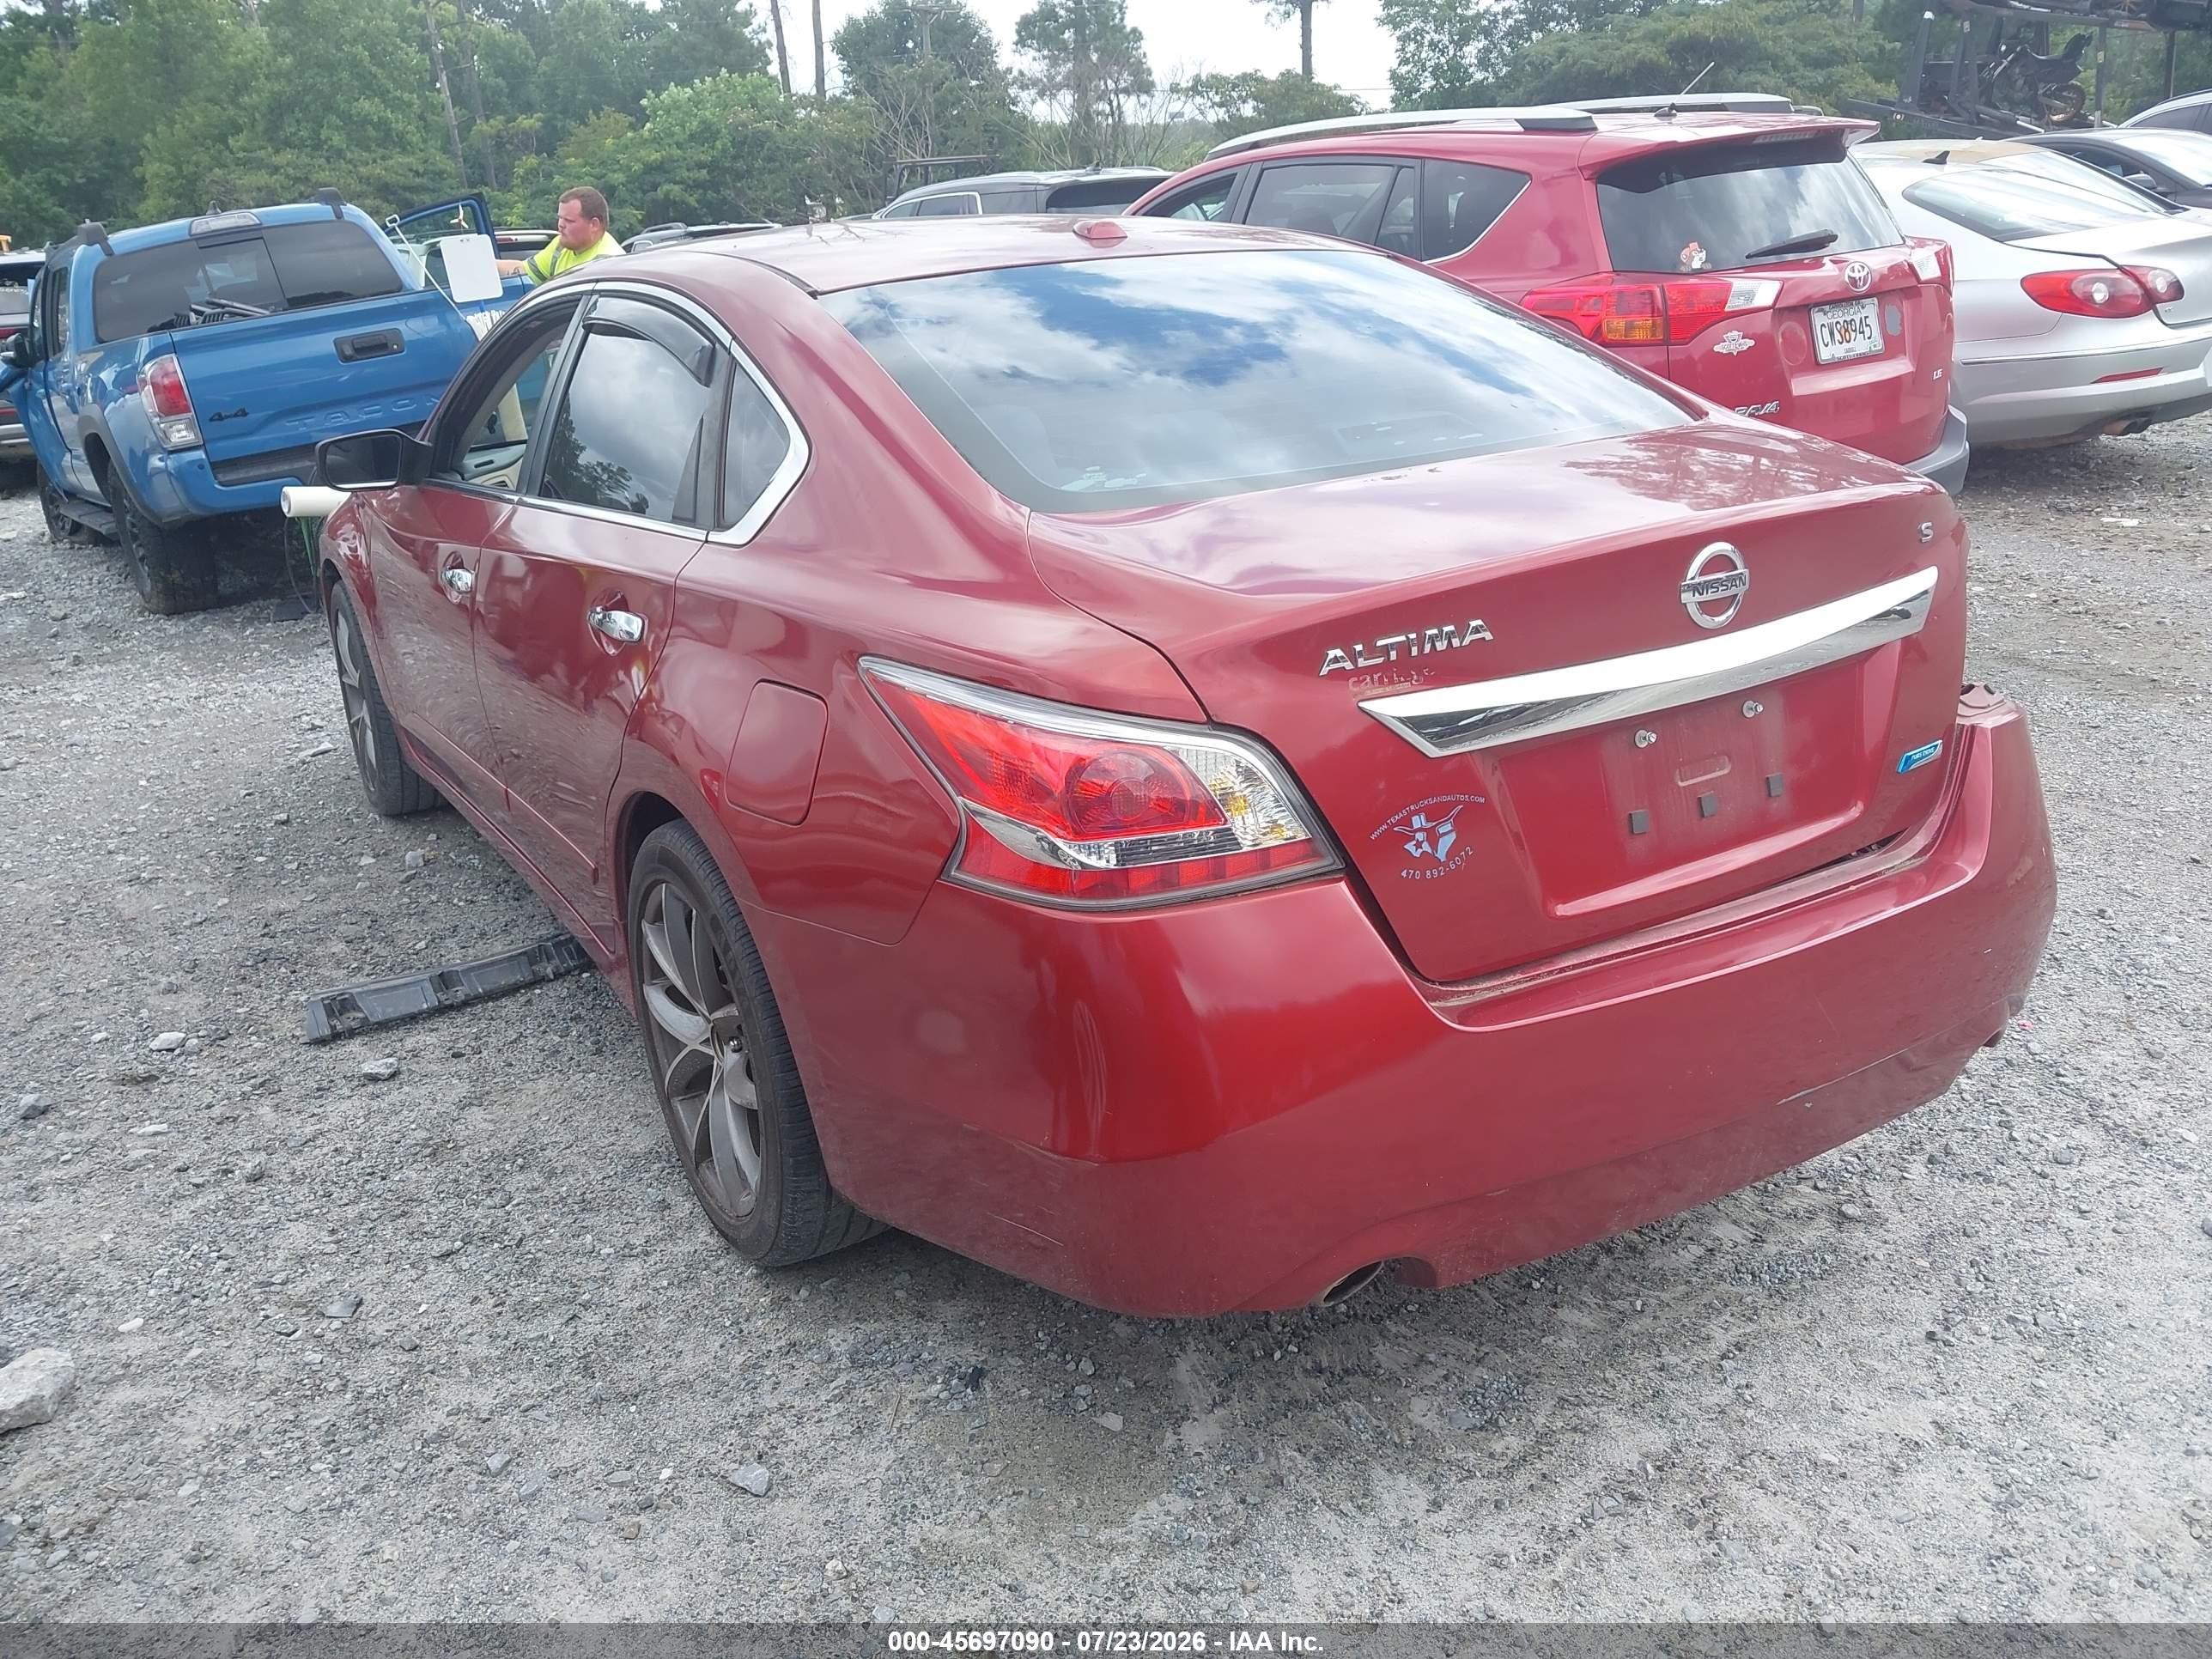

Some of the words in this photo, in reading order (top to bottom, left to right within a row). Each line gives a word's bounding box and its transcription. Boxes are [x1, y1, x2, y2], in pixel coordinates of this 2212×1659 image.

[1826, 307, 1863, 319] GEORGIA
[1820, 315, 1873, 347] CWS8945
[1921, 521, 1934, 543] S
[1691, 574, 1747, 599] NISSAN
[1318, 618, 1494, 677] ALTIMA
[1370, 794, 1486, 840] WWW.TEXASTRUCKSANDAUTOS.COM
[1401, 869, 1420, 880] 470
[1425, 846, 1474, 879] 892-6072
